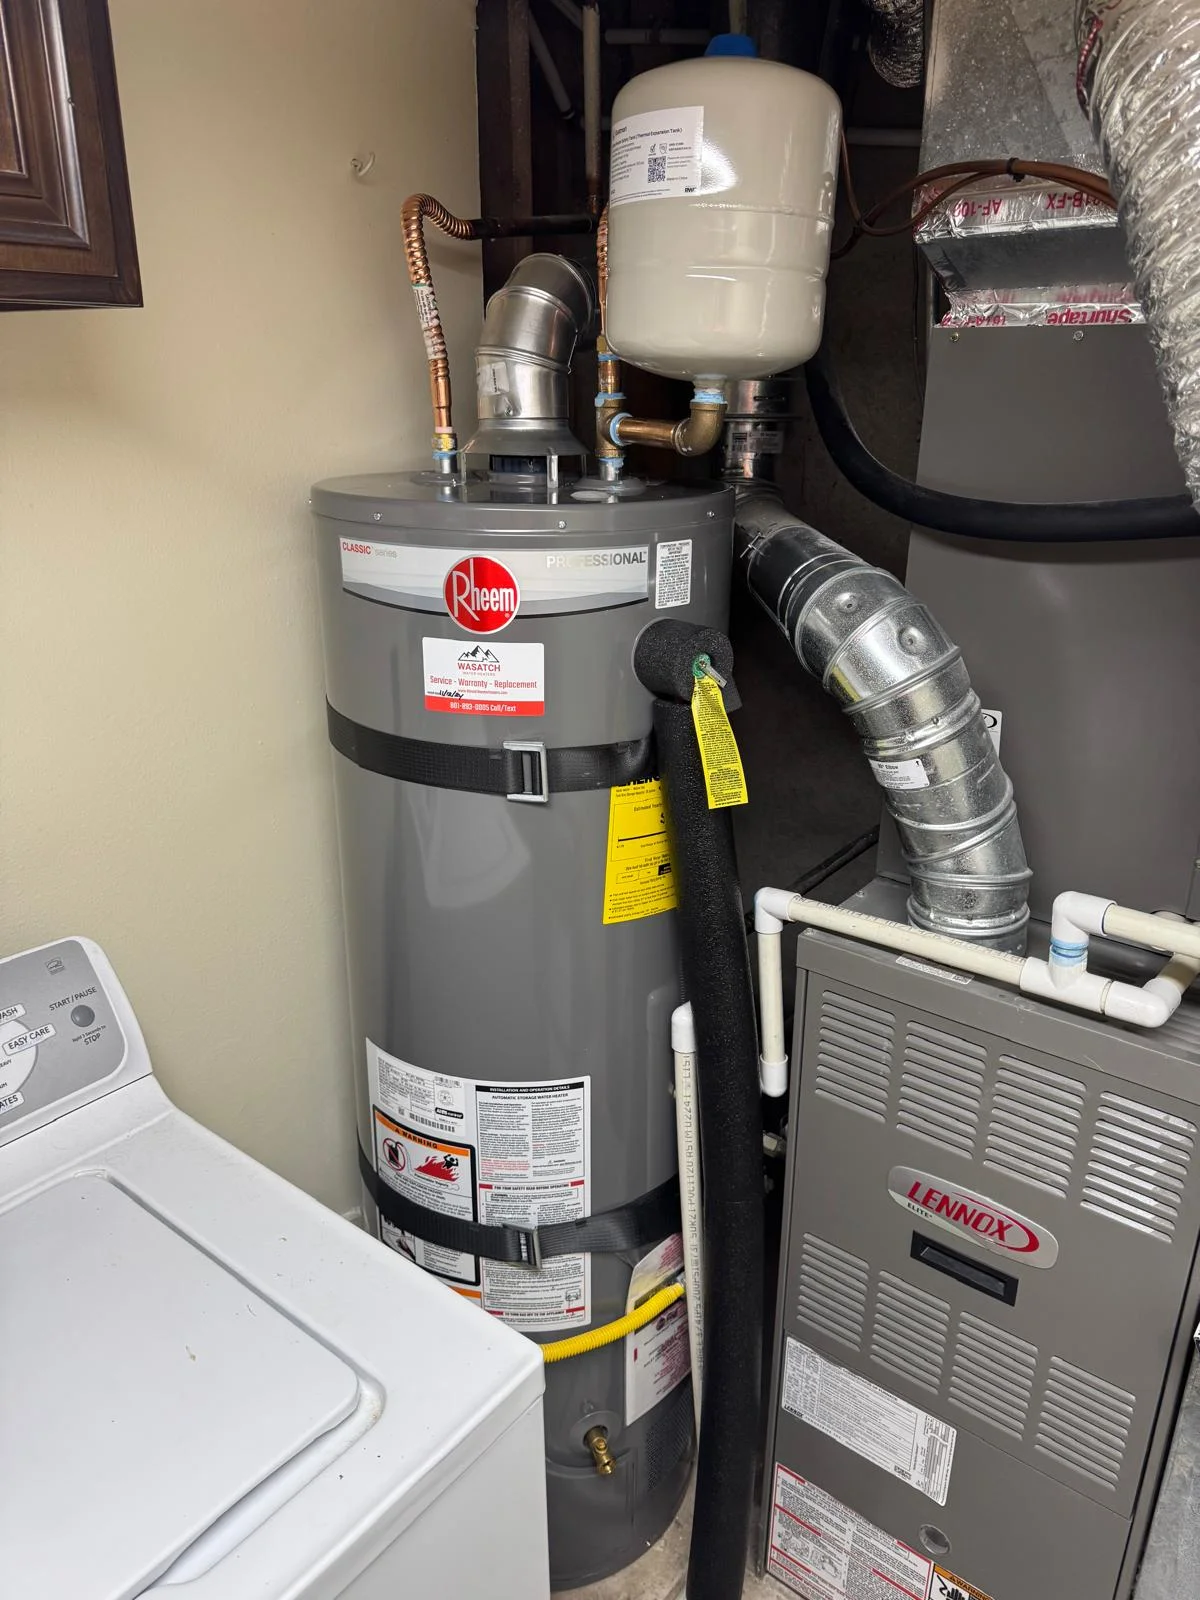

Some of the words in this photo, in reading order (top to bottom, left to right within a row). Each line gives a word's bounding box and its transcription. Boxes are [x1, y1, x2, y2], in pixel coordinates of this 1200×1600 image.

[1047, 308, 1132, 324] Shurtape
[342, 542, 372, 554] CLASSIC
[452, 558, 514, 622] Rheem
[458, 662, 500, 672] WASATCH
[430, 676, 452, 685] Service
[458, 678, 488, 688] Warranty
[494, 680, 537, 689] Replacement
[8, 1036, 28, 1050] EASY
[29, 1026, 50, 1040] CARE
[84, 1032, 100, 1046] STOP
[402, 1131, 438, 1150] WARNING
[908, 1202, 930, 1218] ELITE
[908, 1181, 1012, 1242] LENNOX
